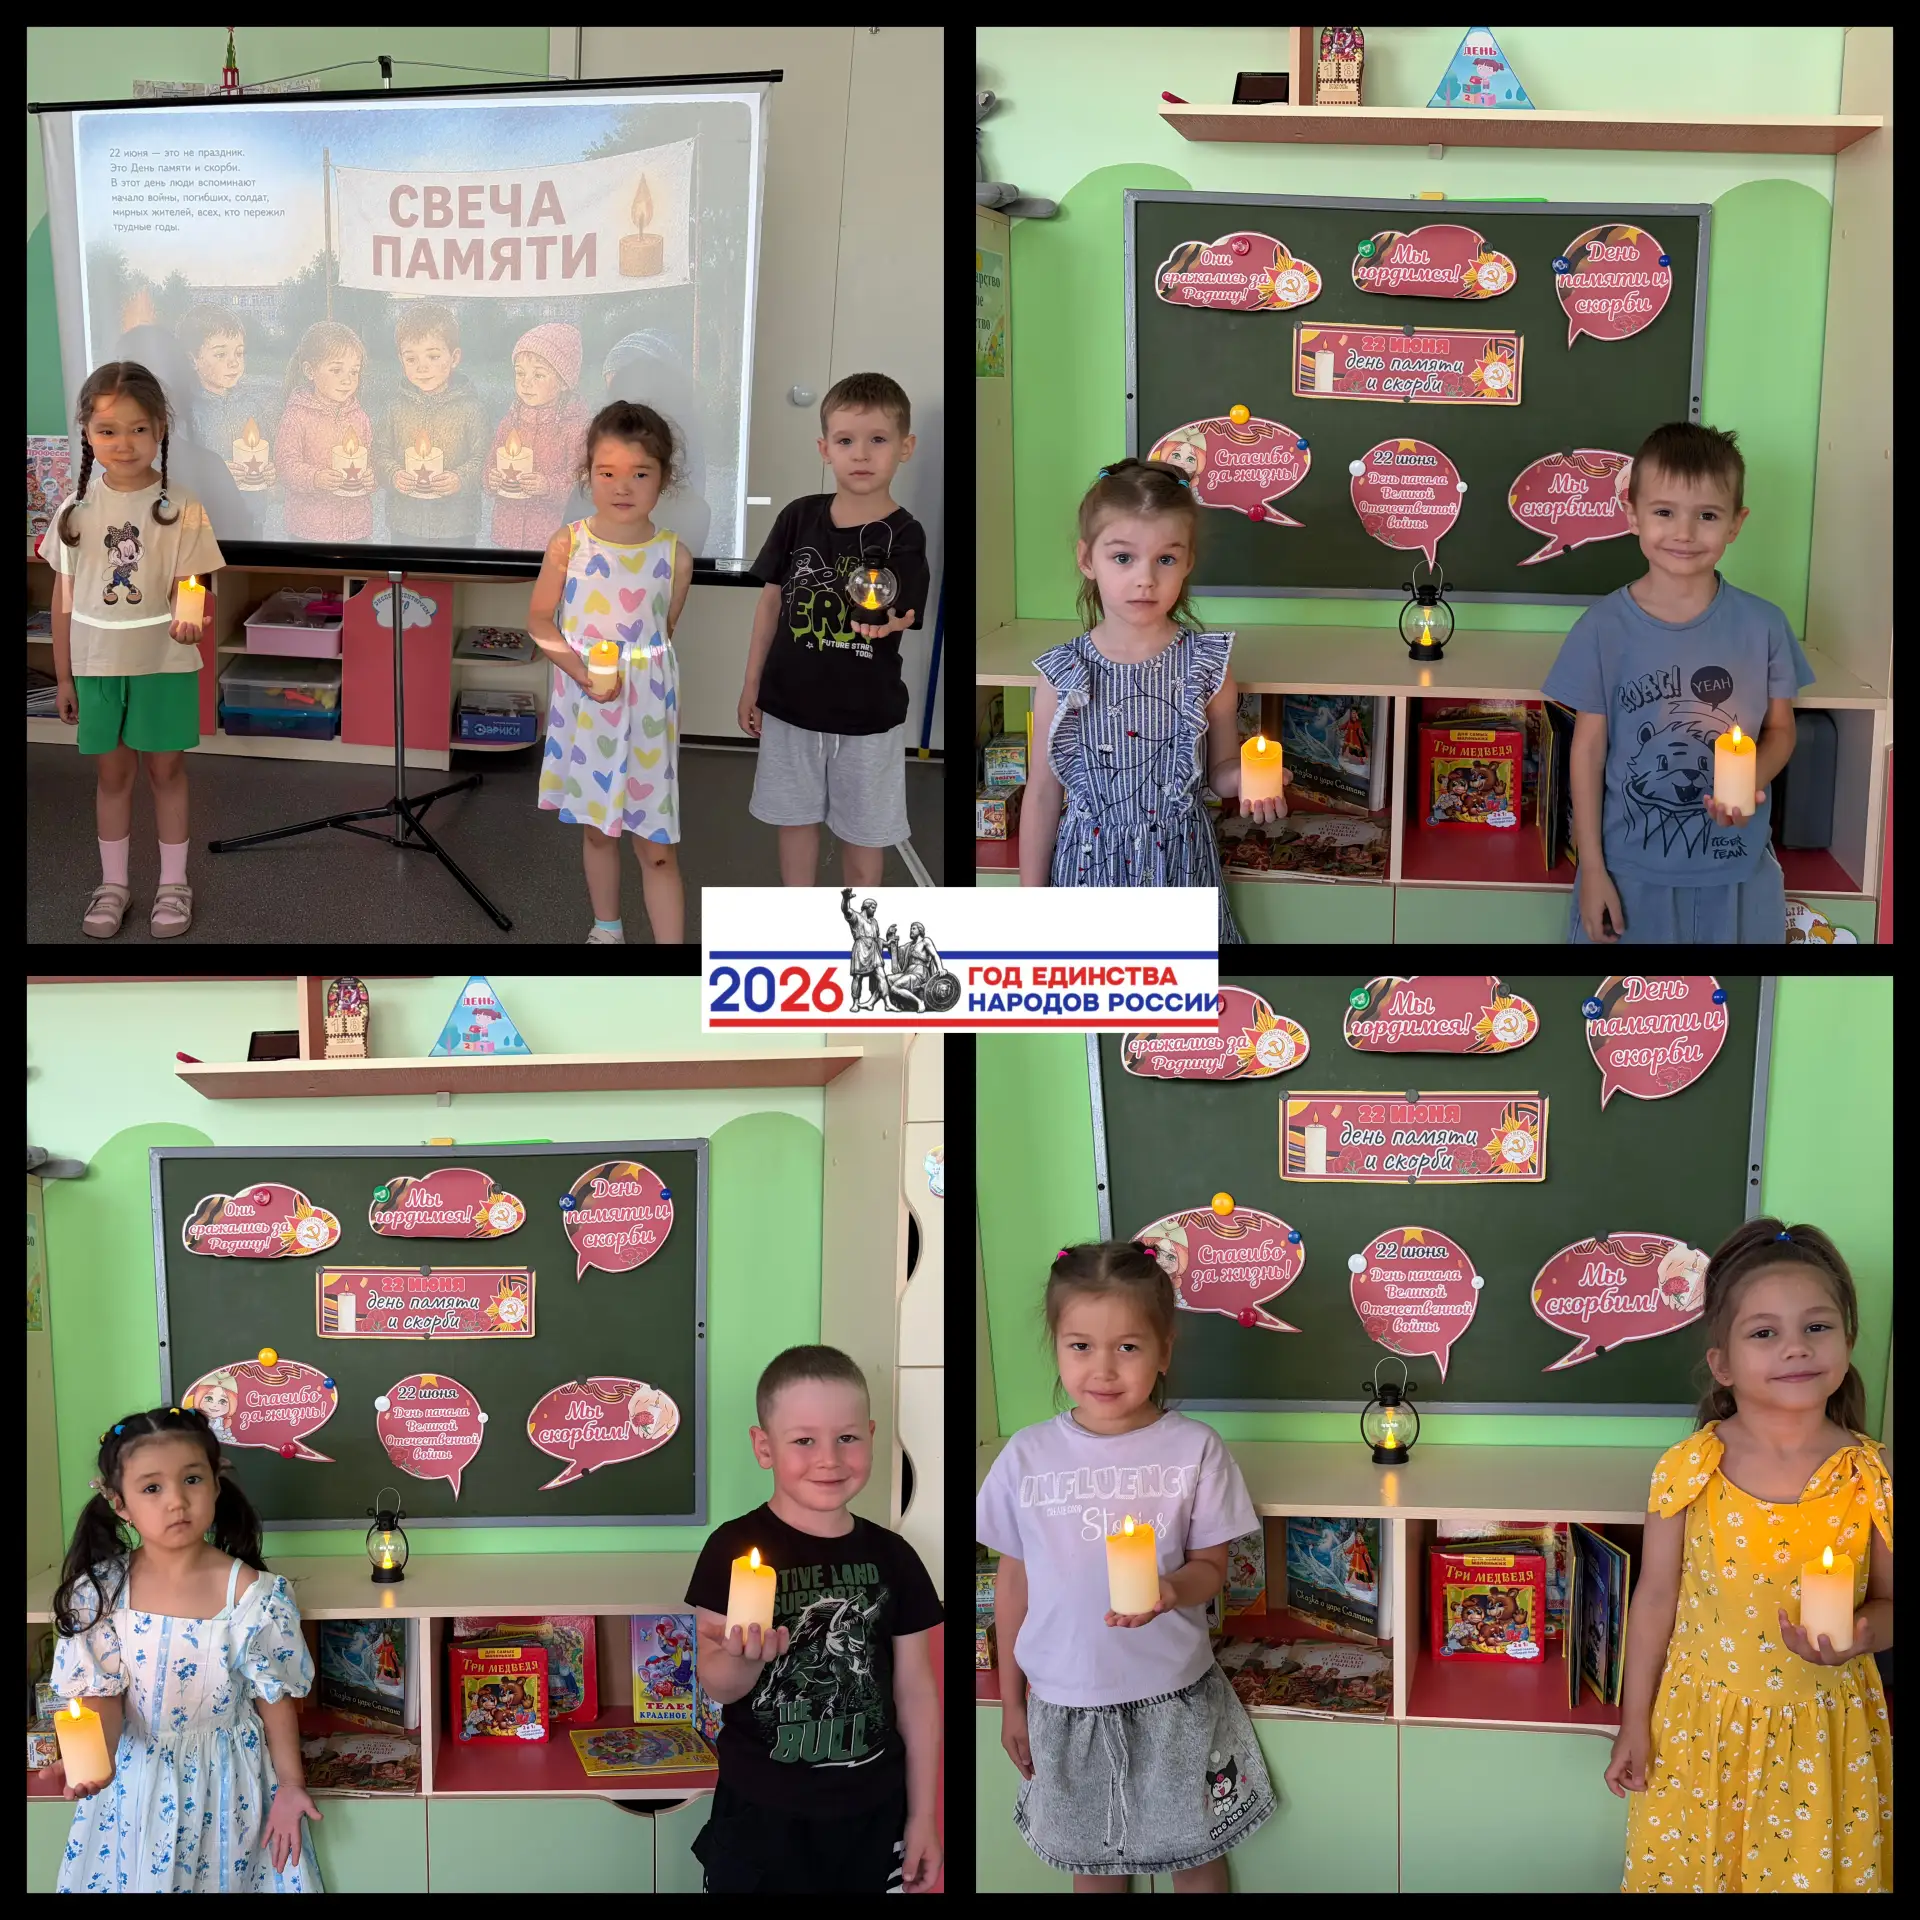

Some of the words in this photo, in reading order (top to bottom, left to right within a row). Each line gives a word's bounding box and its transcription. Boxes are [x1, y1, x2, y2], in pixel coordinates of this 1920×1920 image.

[1463, 46, 1497, 56] ДЕНЬ
[110, 148, 120, 157] 22
[198, 149, 245, 158] праздник.
[110, 163, 128, 172] Это
[131, 163, 154, 173] День
[204, 162, 240, 174] скорби.
[110, 177, 118, 186] В
[144, 179, 166, 188] день
[169, 178, 194, 188] люди
[198, 178, 256, 187] вспоминают
[112, 193, 144, 202] начало
[148, 192, 180, 203] войны,
[182, 192, 232, 203] погибших,
[234, 193, 270, 203] солдат,
[388, 180, 566, 229] СВЕЧА
[112, 208, 148, 217] мирных
[152, 207, 194, 218] жителей,
[197, 208, 222, 217] всех,
[224, 208, 240, 216] кто
[244, 207, 286, 217] пережил
[113, 223, 152, 232] трудные
[154, 222, 180, 232] годы.
[372, 232, 598, 282] ПАМЯТИ
[1200, 250, 1234, 266] Они
[1390, 244, 1430, 265] Мы
[1586, 240, 1640, 262] День
[1162, 272, 1248, 288] сражались
[1249, 272, 1270, 290] за
[1358, 264, 1462, 285] гордимся!
[1558, 272, 1650, 290] памяти
[1650, 270, 1669, 288] и
[1182, 288, 1248, 305] Родину!
[1574, 290, 1652, 321] скорби
[1361, 336, 1386, 352] 22
[1388, 337, 1450, 354] ИЮНЯ
[1345, 348, 1385, 371] день
[1390, 356, 1464, 374] памяти
[1366, 378, 1378, 392] и
[1383, 371, 1443, 398] скорби
[1214, 445, 1295, 467] Спасибо
[1373, 450, 1394, 464] 22
[1396, 454, 1438, 466] июня
[1207, 470, 1232, 490] за
[1234, 462, 1299, 488] жизнь!
[1368, 472, 1398, 486] День
[1399, 474, 1449, 486] начала
[1548, 473, 1589, 494] Мы
[1380, 485, 1436, 500] Великой
[1359, 500, 1458, 515] Отечественной
[1520, 494, 1616, 524] скорбим!
[1386, 516, 1428, 530] войны
[822, 639, 850, 649] FUTURE
[1692, 676, 1731, 694] YEAH
[1713, 848, 1748, 860] TEAM
[1622, 976, 1690, 1002] День
[463, 997, 495, 1006] ДЕНЬ
[1388, 991, 1435, 1016] Мы
[1351, 1013, 1472, 1044] гордимся!
[1590, 1012, 1702, 1036] памяти
[1704, 1010, 1724, 1030] и
[1128, 1036, 1224, 1058] сражались
[1226, 1034, 1250, 1054] за
[1610, 1036, 1704, 1076] скорби
[1150, 1054, 1226, 1075] Родину!
[1358, 1104, 1386, 1124] 22
[1390, 1104, 1461, 1124] ИЮНЯ
[1340, 1121, 1386, 1146] день
[1392, 1128, 1478, 1147] памяти
[1364, 1154, 1377, 1170] и
[1384, 1147, 1453, 1176] скорби
[404, 1188, 444, 1208] Мы
[590, 1178, 644, 1198] День
[224, 1202, 256, 1218] Они
[375, 1205, 473, 1226] гордимся!
[566, 1206, 653, 1226] памяти
[654, 1206, 672, 1222] и
[188, 1222, 270, 1240] сражались
[271, 1222, 291, 1240] за
[582, 1223, 656, 1254] скорби
[208, 1236, 272, 1253] Родину!
[1198, 1238, 1286, 1265] Спасибо
[1376, 1242, 1399, 1259] 22
[1400, 1245, 1450, 1260] июня
[381, 1276, 404, 1292] 22
[407, 1276, 466, 1292] ИЮНЯ
[1191, 1268, 1219, 1292] за
[1220, 1258, 1292, 1289] жизнь!
[1370, 1268, 1406, 1282] День
[1408, 1268, 1462, 1282] начала
[1578, 1262, 1628, 1286] Мы
[367, 1290, 404, 1310] день
[410, 1296, 480, 1310] памяти
[1385, 1282, 1448, 1299] Великой
[1360, 1300, 1473, 1316] Отечественной
[1545, 1287, 1660, 1323] скорбим!
[386, 1316, 399, 1330] и
[402, 1309, 460, 1335] скорби
[1392, 1316, 1440, 1333] войны
[245, 1384, 323, 1408] Спасибо
[398, 1386, 418, 1400] 22
[418, 1387, 458, 1400] июня
[240, 1411, 264, 1430] за
[264, 1404, 326, 1428] жизнь!
[393, 1406, 424, 1419] День
[424, 1406, 470, 1418] начала
[565, 1400, 604, 1420] Мы
[406, 1418, 458, 1433] Великой
[539, 1420, 632, 1450] скорбим!
[385, 1432, 480, 1446] Отечественной
[412, 1446, 452, 1460] войны
[1047, 1506, 1066, 1516] CREATE
[1082, 1506, 1171, 1541] Stoies
[777, 1564, 824, 1592] TIVE
[830, 1563, 880, 1585] LAND
[1296, 1588, 1320, 1605] Сказка
[1342, 1606, 1374, 1625] Салтане
[778, 1699, 814, 1723] THE
[770, 1712, 868, 1763] BULL
[1210, 1821, 1228, 1840] Hee
[1226, 1808, 1244, 1826] hee
[1242, 1790, 1258, 1812] hee!
